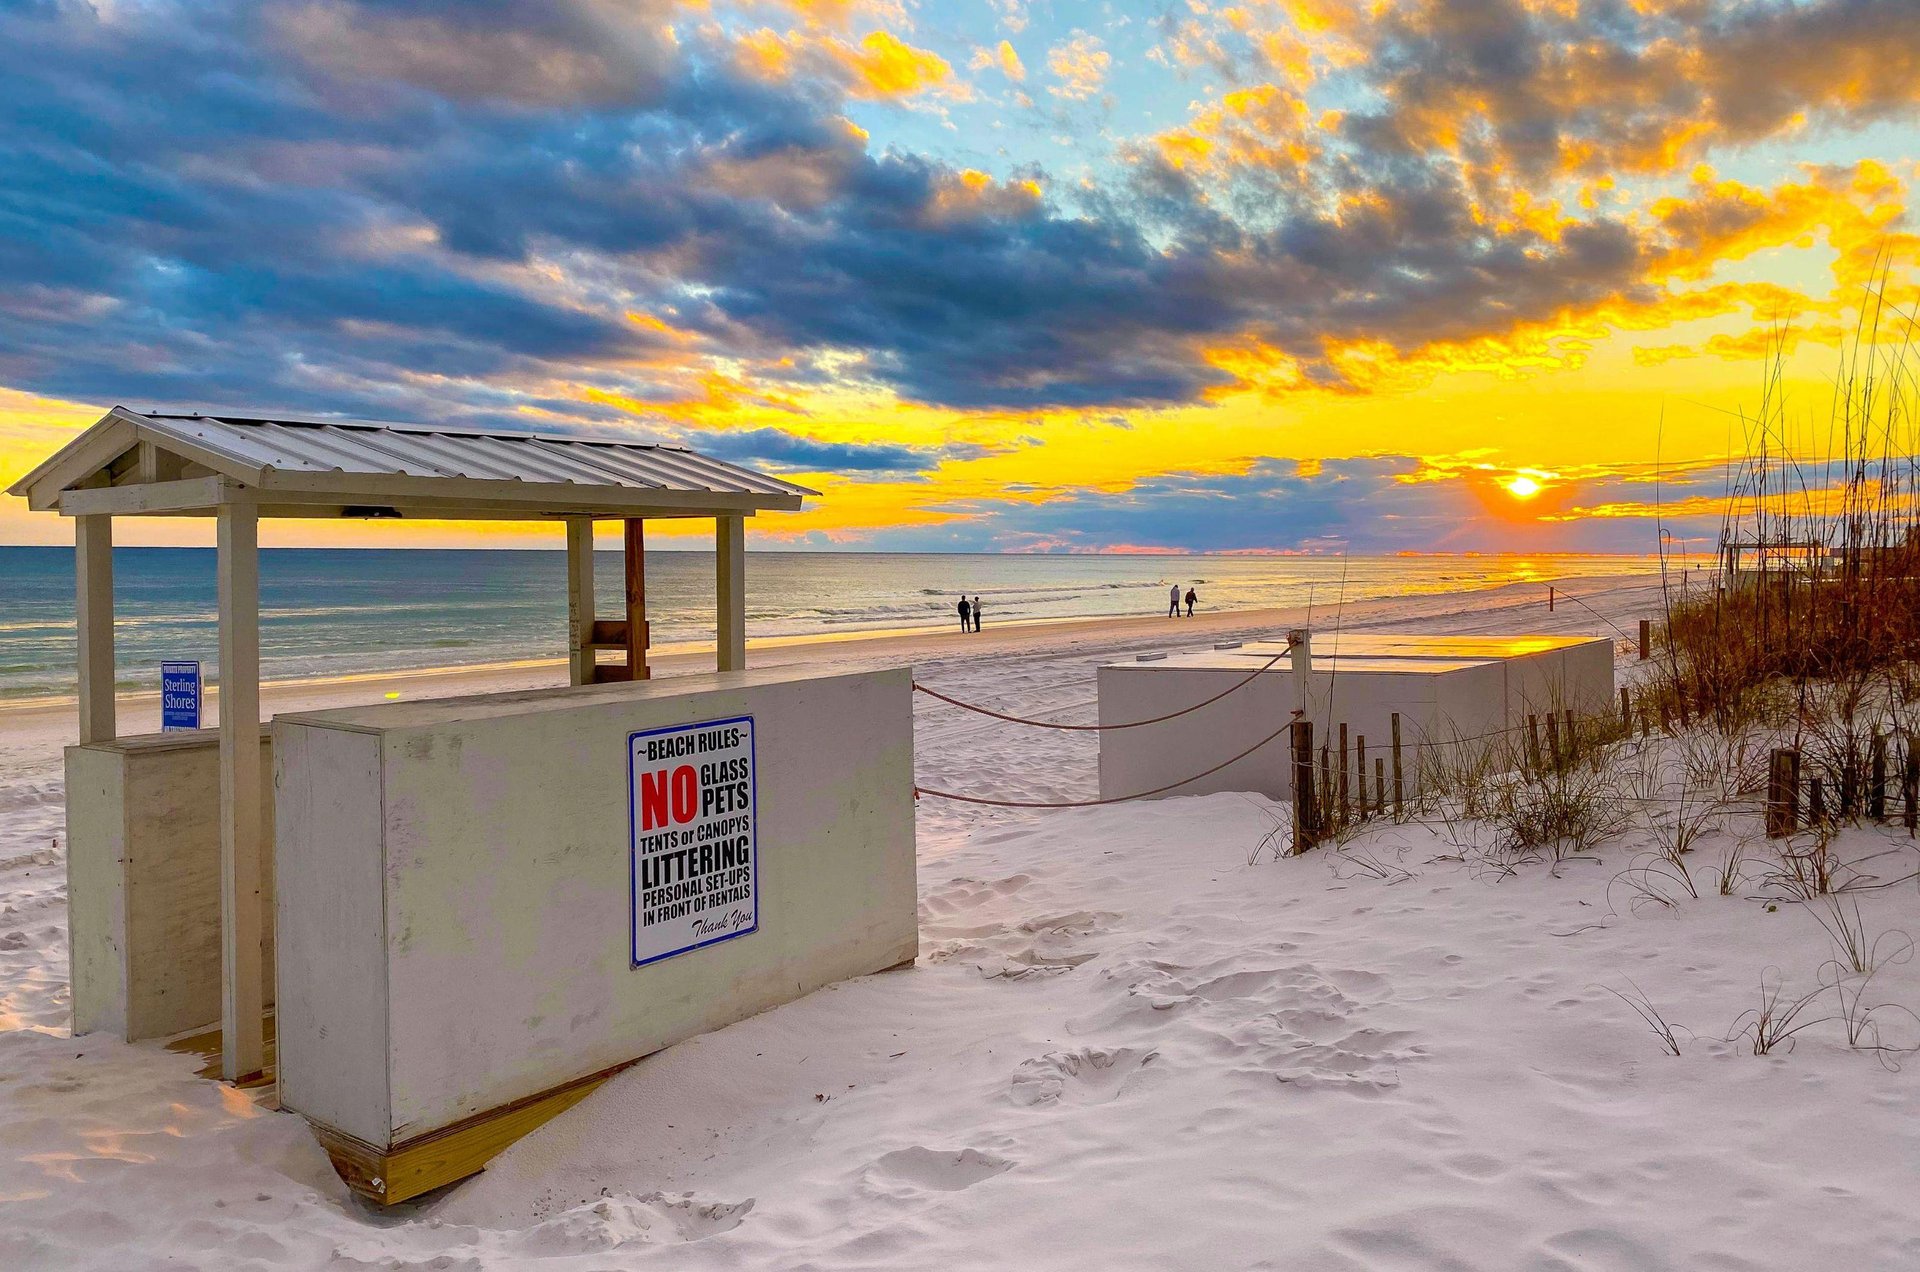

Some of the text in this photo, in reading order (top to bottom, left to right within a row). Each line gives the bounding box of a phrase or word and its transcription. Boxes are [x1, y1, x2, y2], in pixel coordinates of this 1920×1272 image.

[178, 665, 196, 674] PROPERTY
[164, 678, 196, 695] Sterling
[165, 693, 196, 709] Shores
[641, 764, 698, 832] NO
[640, 830, 678, 855] TENTS
[681, 829, 694, 845] or
[643, 865, 750, 910] PERSONAL SET-UPS
[643, 883, 750, 928] IN FRONT OF RENTALS
[691, 909, 753, 938] Thank You
